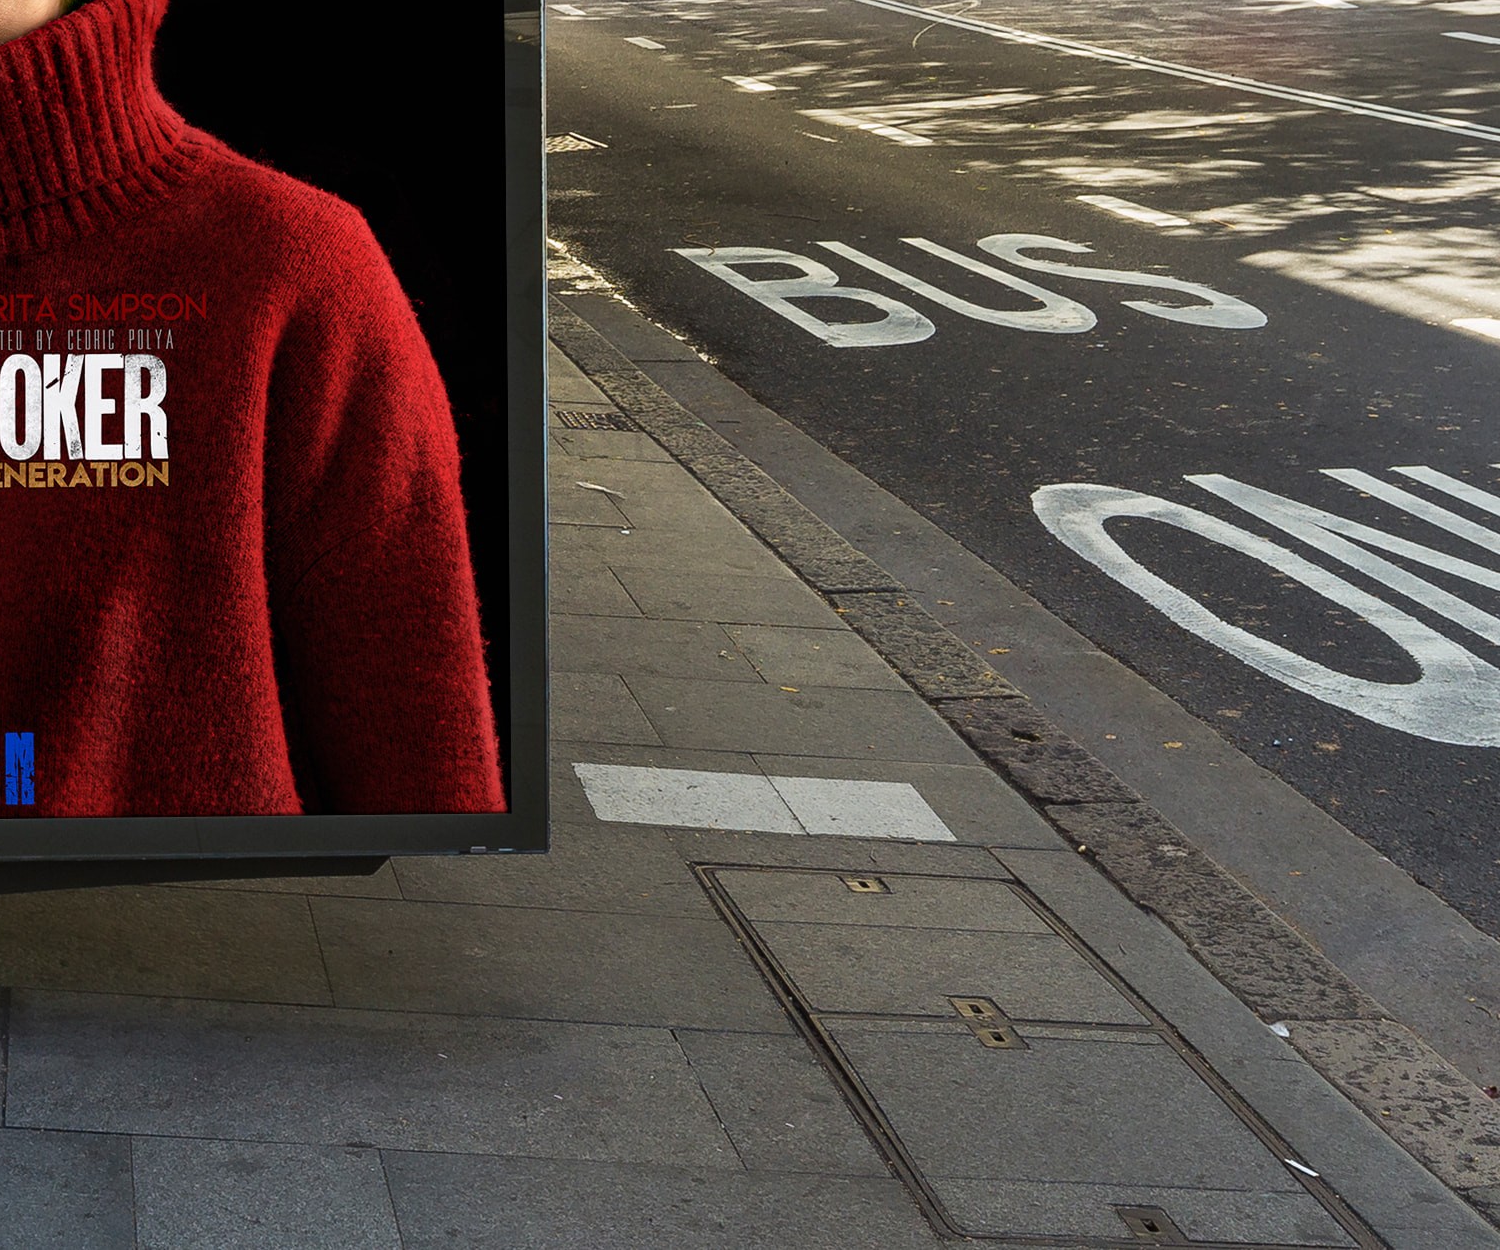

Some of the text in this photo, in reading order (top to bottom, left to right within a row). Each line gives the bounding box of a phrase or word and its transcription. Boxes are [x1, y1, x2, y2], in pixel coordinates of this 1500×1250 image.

[667, 233, 1268, 348] BUS
[68, 293, 208, 322] SIMPSON
[36, 329, 54, 351] BY
[67, 328, 115, 351] CEDRIC
[128, 328, 174, 350] POLYA
